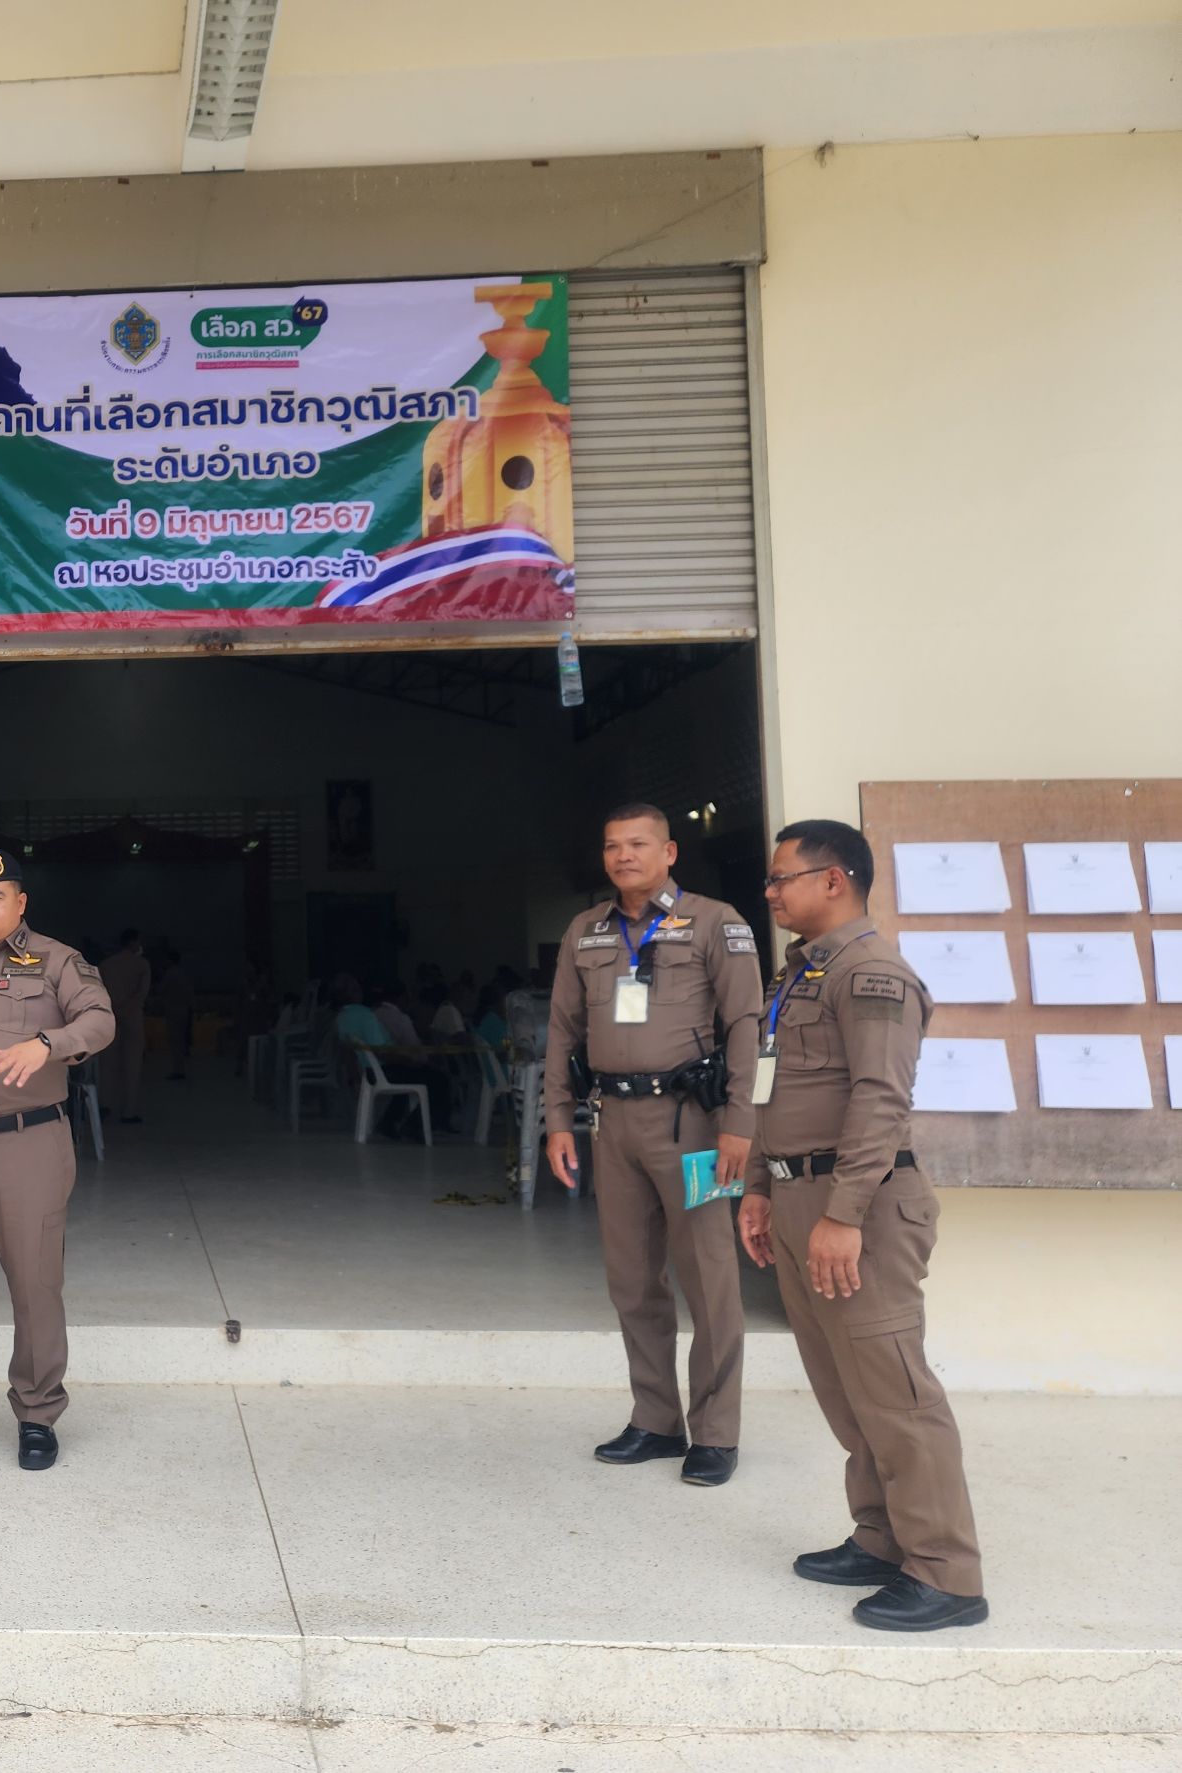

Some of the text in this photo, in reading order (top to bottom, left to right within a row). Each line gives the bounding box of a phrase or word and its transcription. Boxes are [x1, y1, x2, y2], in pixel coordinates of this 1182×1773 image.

[201, 314, 301, 337] เลือก สว.
[116, 443, 317, 481] ระดับอำเภอ
[69, 502, 372, 541] วันที่ 9 มิถุนายน 2567
[57, 553, 378, 587] ณ หอประชุมอำเภอกระสัง
